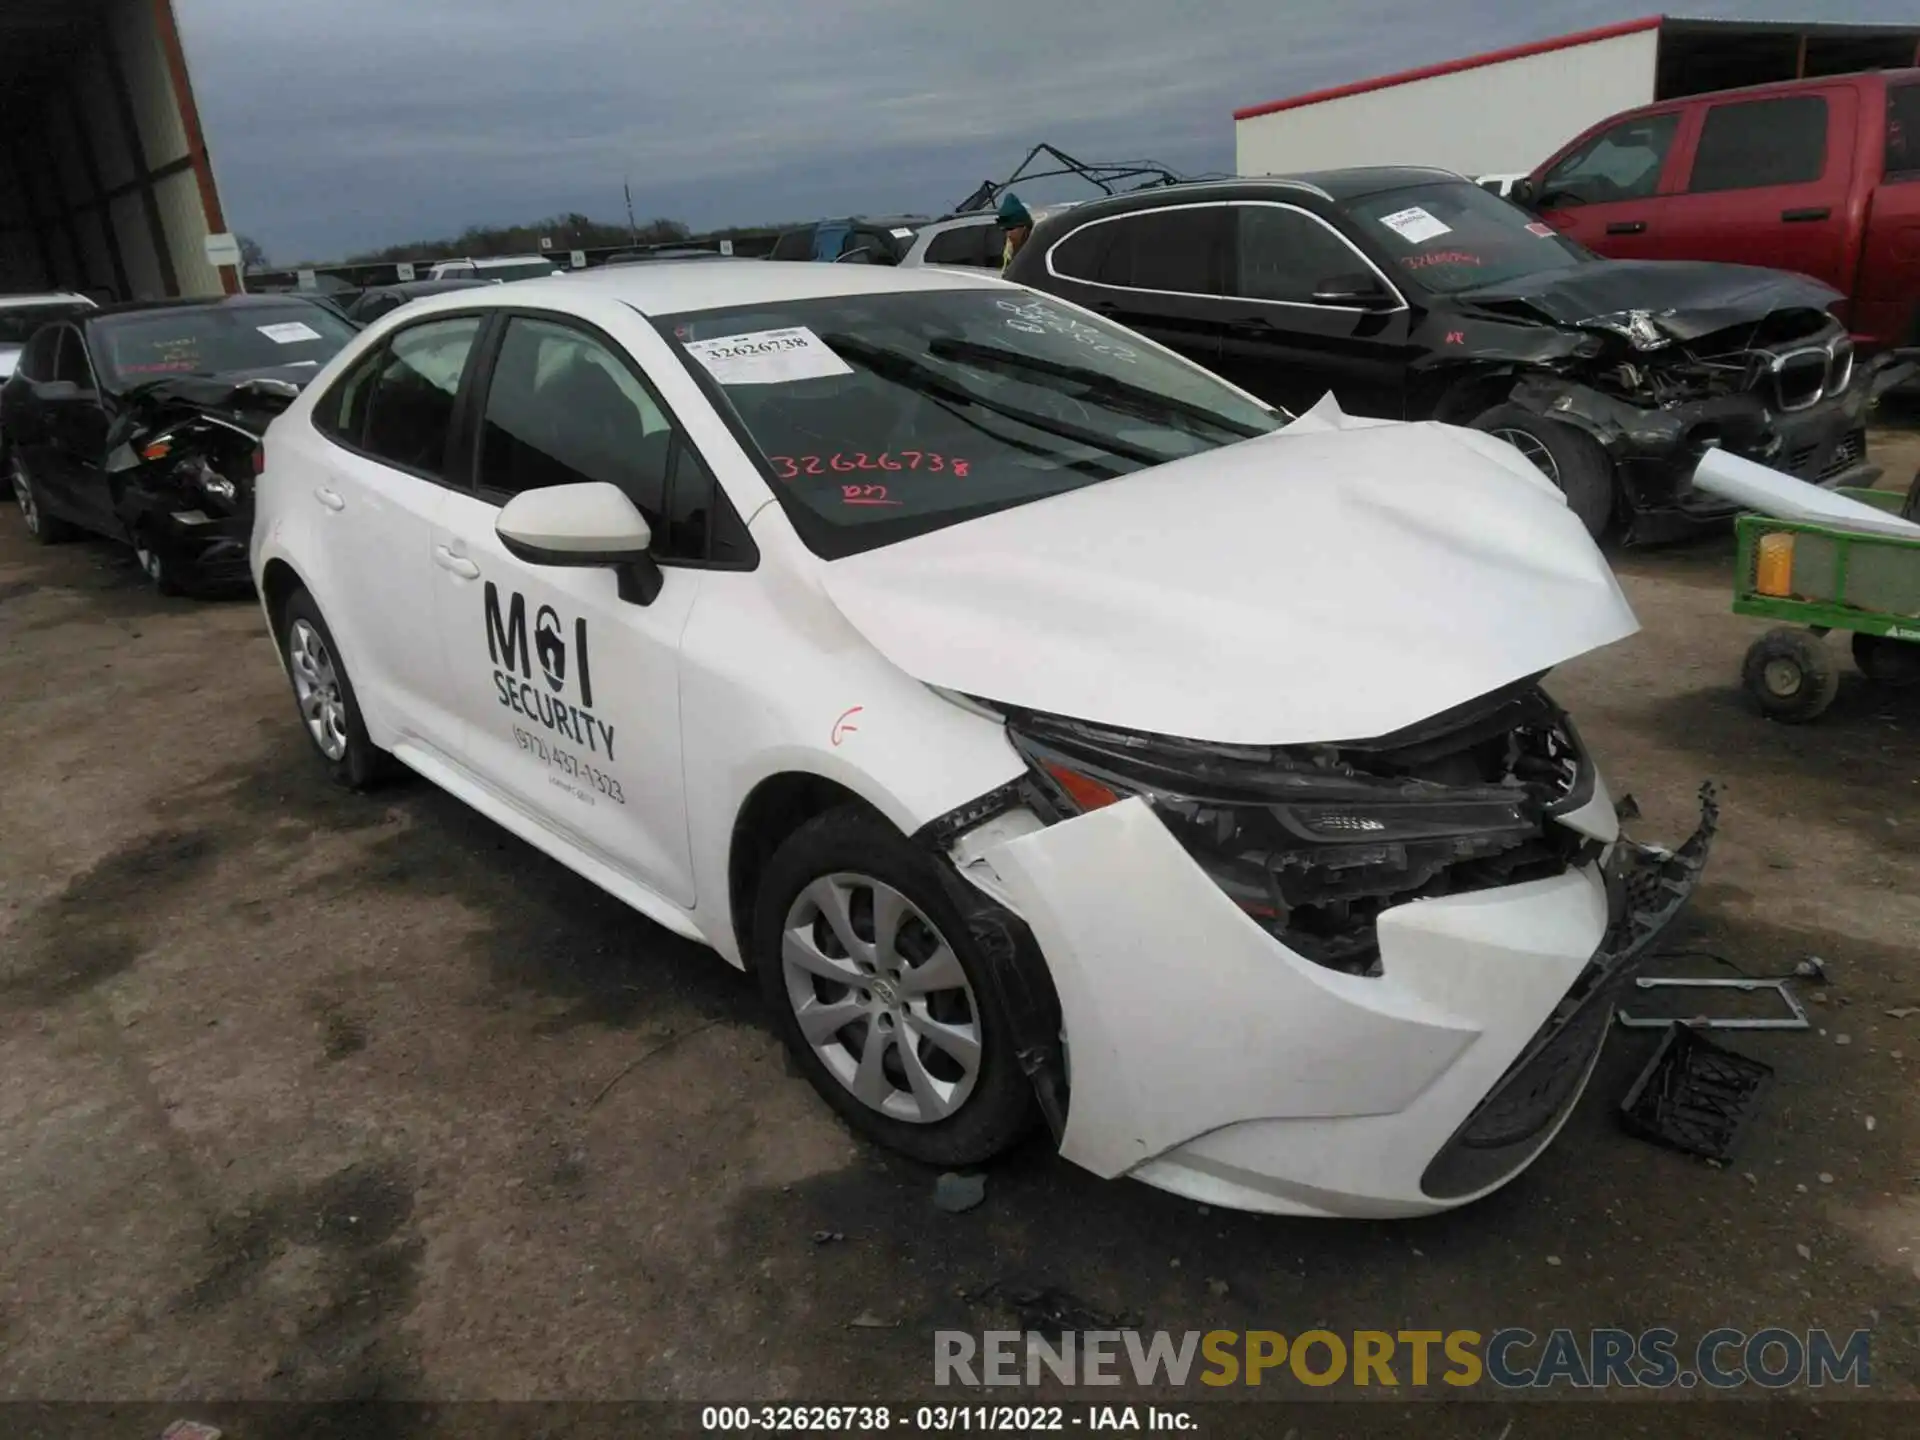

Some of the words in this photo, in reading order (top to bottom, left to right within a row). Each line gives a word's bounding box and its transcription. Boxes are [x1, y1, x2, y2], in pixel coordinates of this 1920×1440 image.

[705, 337, 809, 361] 32626738
[770, 451, 970, 478] 32626738
[493, 669, 615, 762] SECURITY
